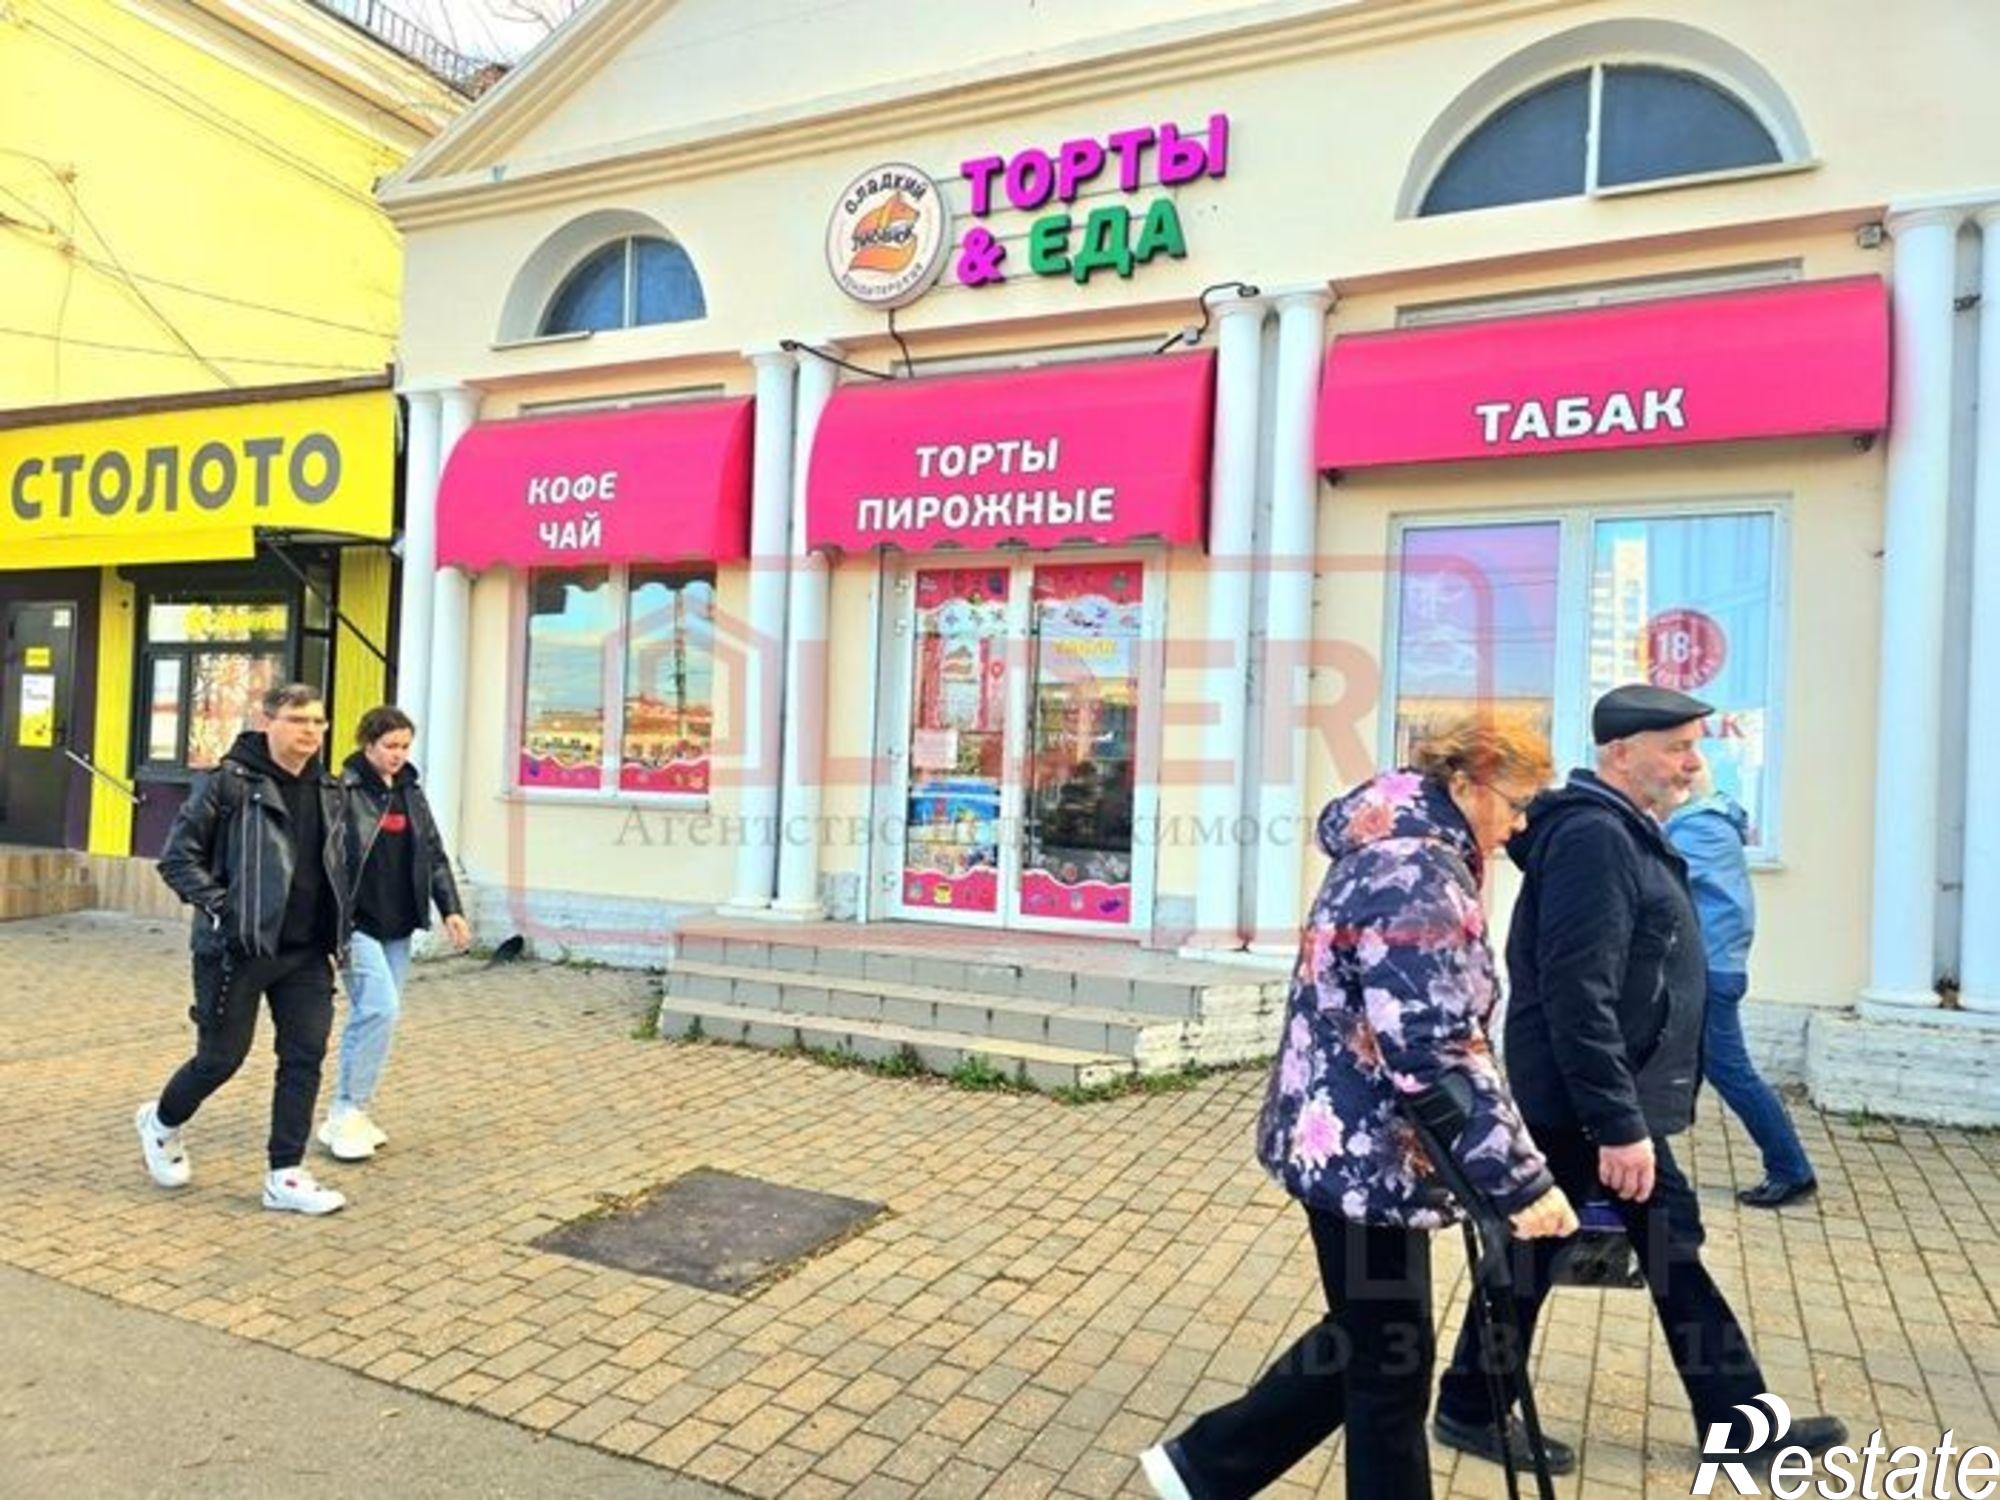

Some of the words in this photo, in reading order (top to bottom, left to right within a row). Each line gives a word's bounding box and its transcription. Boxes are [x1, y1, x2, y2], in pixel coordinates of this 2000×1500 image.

[960, 113, 1230, 218] ТОРТЫ
[957, 226, 1007, 288] &
[1028, 196, 1188, 284] ЕДА
[1475, 387, 1686, 443] ТАБАК
[11, 432, 342, 521] СТОЛОТО
[915, 437, 1060, 479] ТОРТЫ
[527, 470, 619, 505] КОФЕ
[857, 486, 1116, 531] ПИРОЖНЫЕ
[538, 510, 602, 550] ЧАЙ
